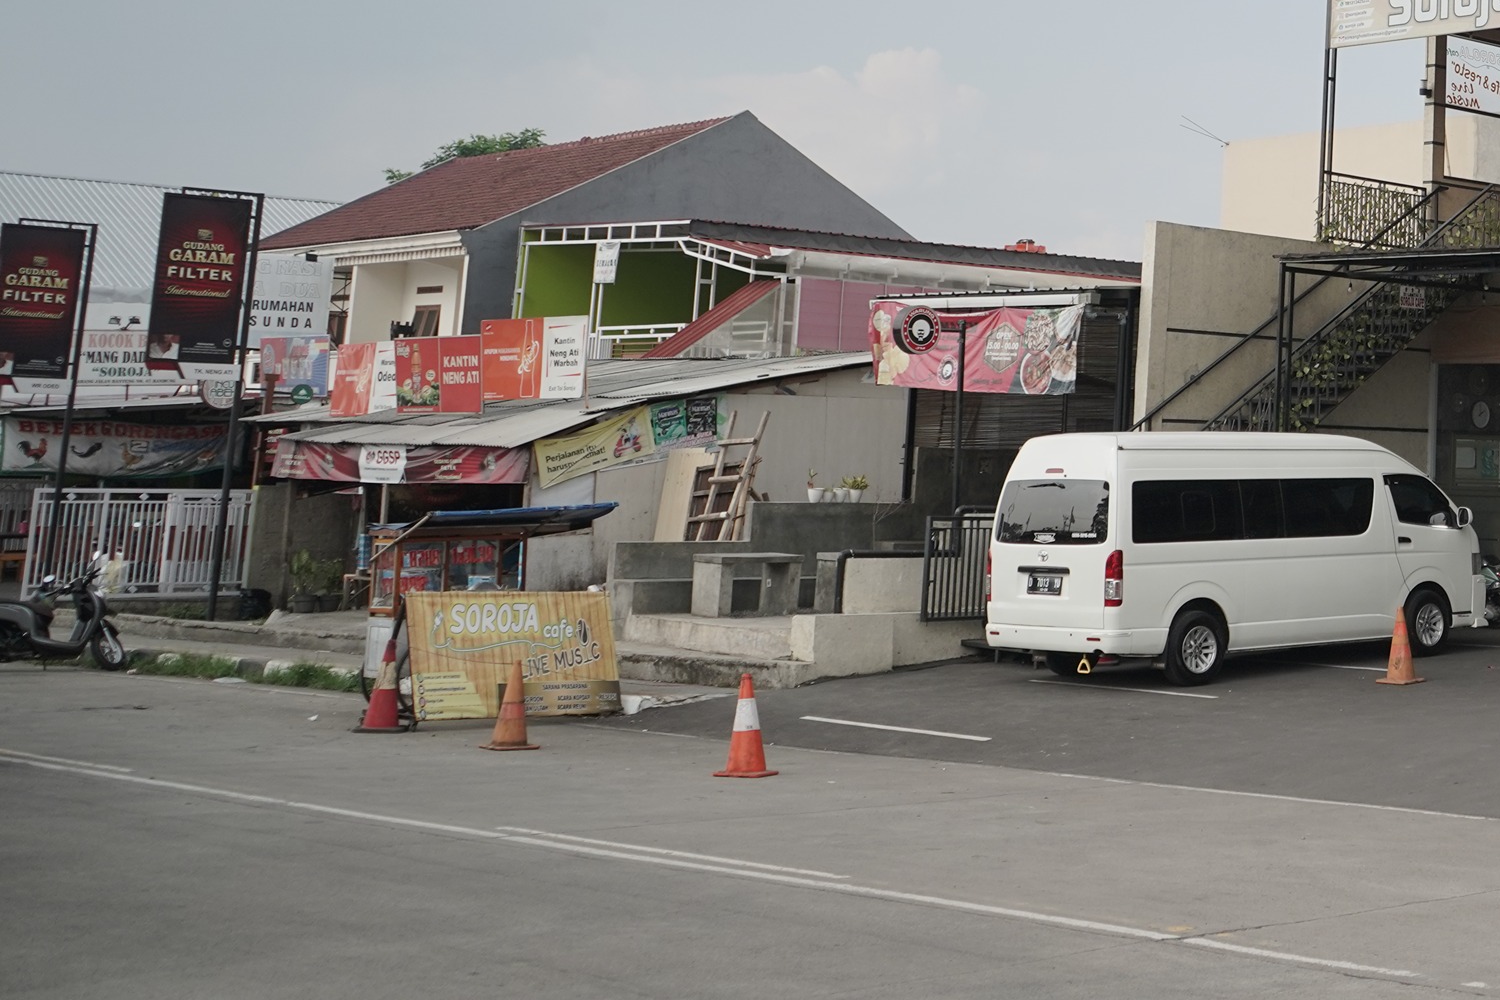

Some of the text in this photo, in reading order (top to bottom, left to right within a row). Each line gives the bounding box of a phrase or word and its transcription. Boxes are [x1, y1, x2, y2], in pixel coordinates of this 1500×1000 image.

[183, 241, 224, 251] GUDANG
[169, 249, 235, 265] GARAM
[19, 267, 58, 277] GUDANG
[167, 265, 233, 281] FILTER
[5, 274, 69, 290] GARAM
[3, 289, 66, 304] FILTER
[164, 285, 230, 298] International
[1, 306, 64, 320] International
[89, 333, 133, 348] KOCOK
[554, 337, 575, 345] Kantin
[550, 348, 579, 358] Neng Ati
[443, 355, 479, 368] KANTIN
[553, 359, 578, 367] Warbah
[442, 371, 480, 385] NENG ATI
[377, 450, 400, 464] GGSP
[545, 448, 585, 463] Perjalanan
[450, 603, 540, 635] SOROJA
[542, 618, 574, 642] cafe
[553, 641, 600, 671] MUSIC
